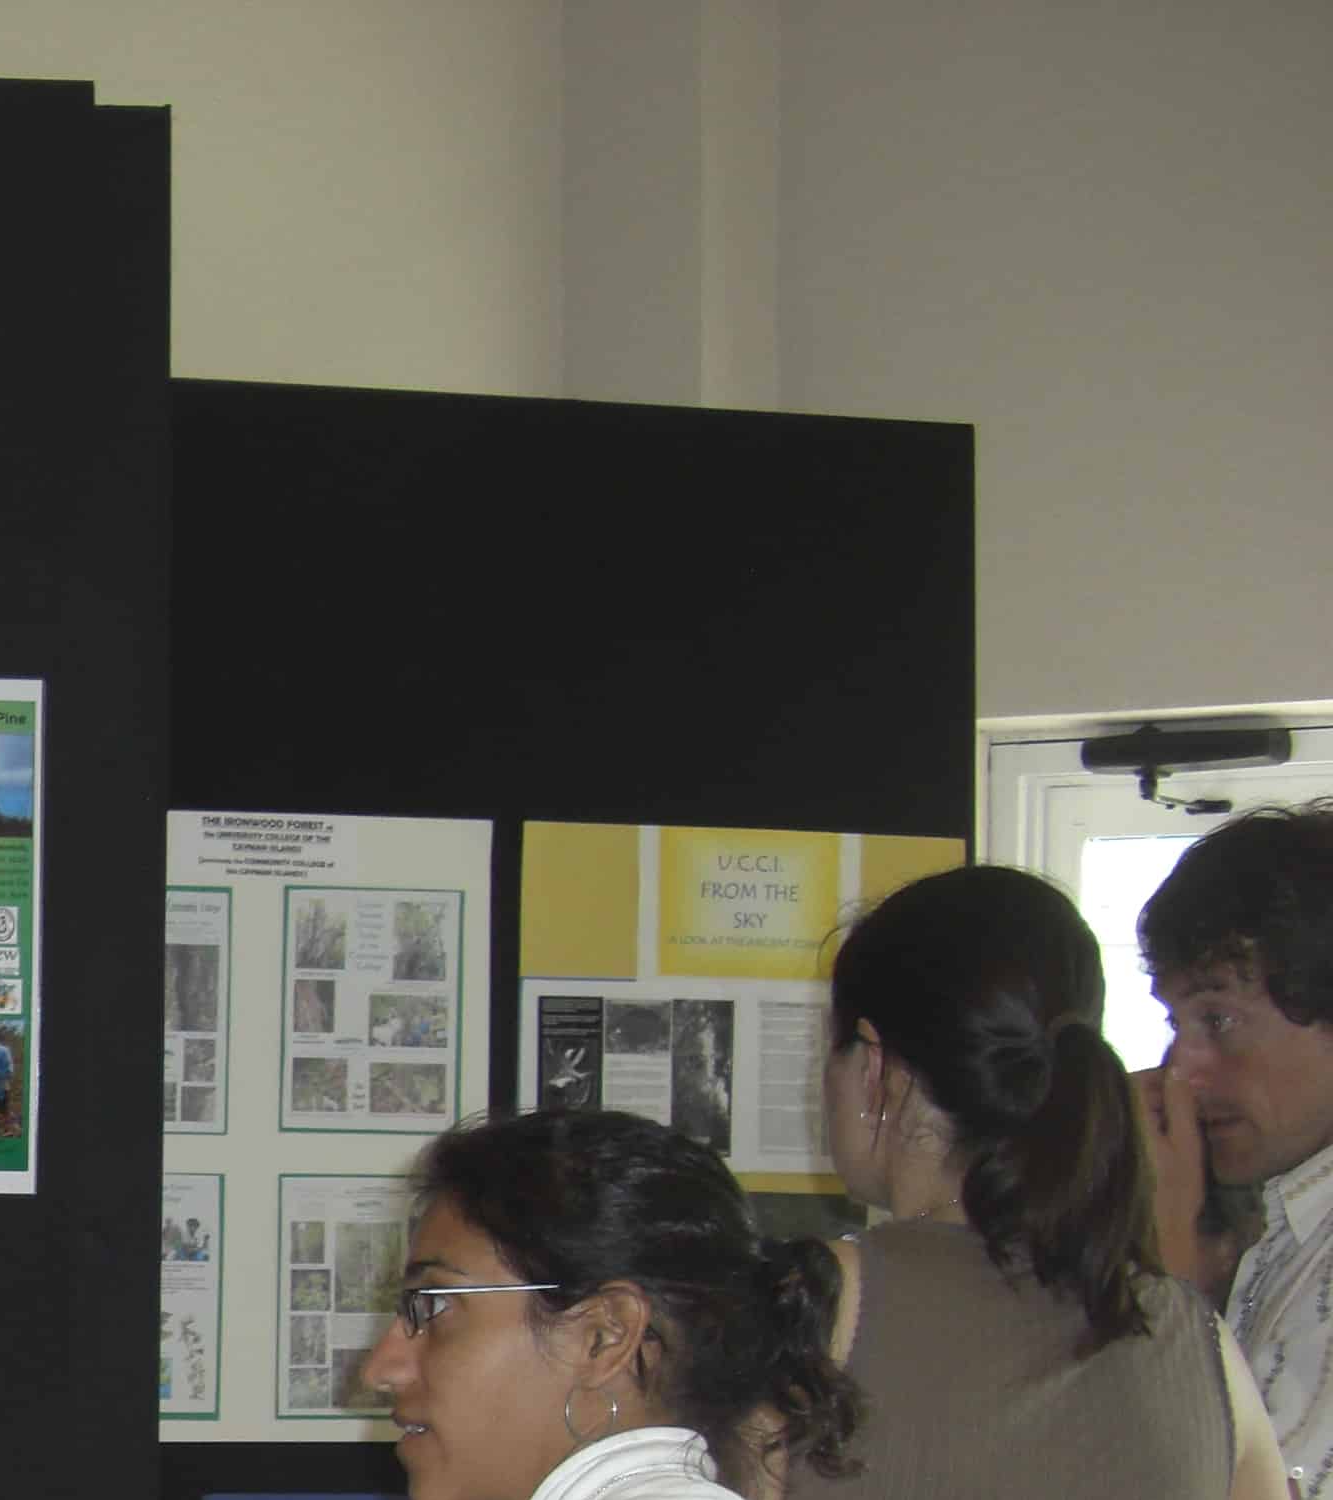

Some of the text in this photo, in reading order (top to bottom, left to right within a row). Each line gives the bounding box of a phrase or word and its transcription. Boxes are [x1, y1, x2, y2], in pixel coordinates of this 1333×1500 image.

[201, 816, 325, 831] THE IRONWOOD FOREST
[700, 881, 799, 903] FROM THE
[732, 911, 768, 929] SKY
